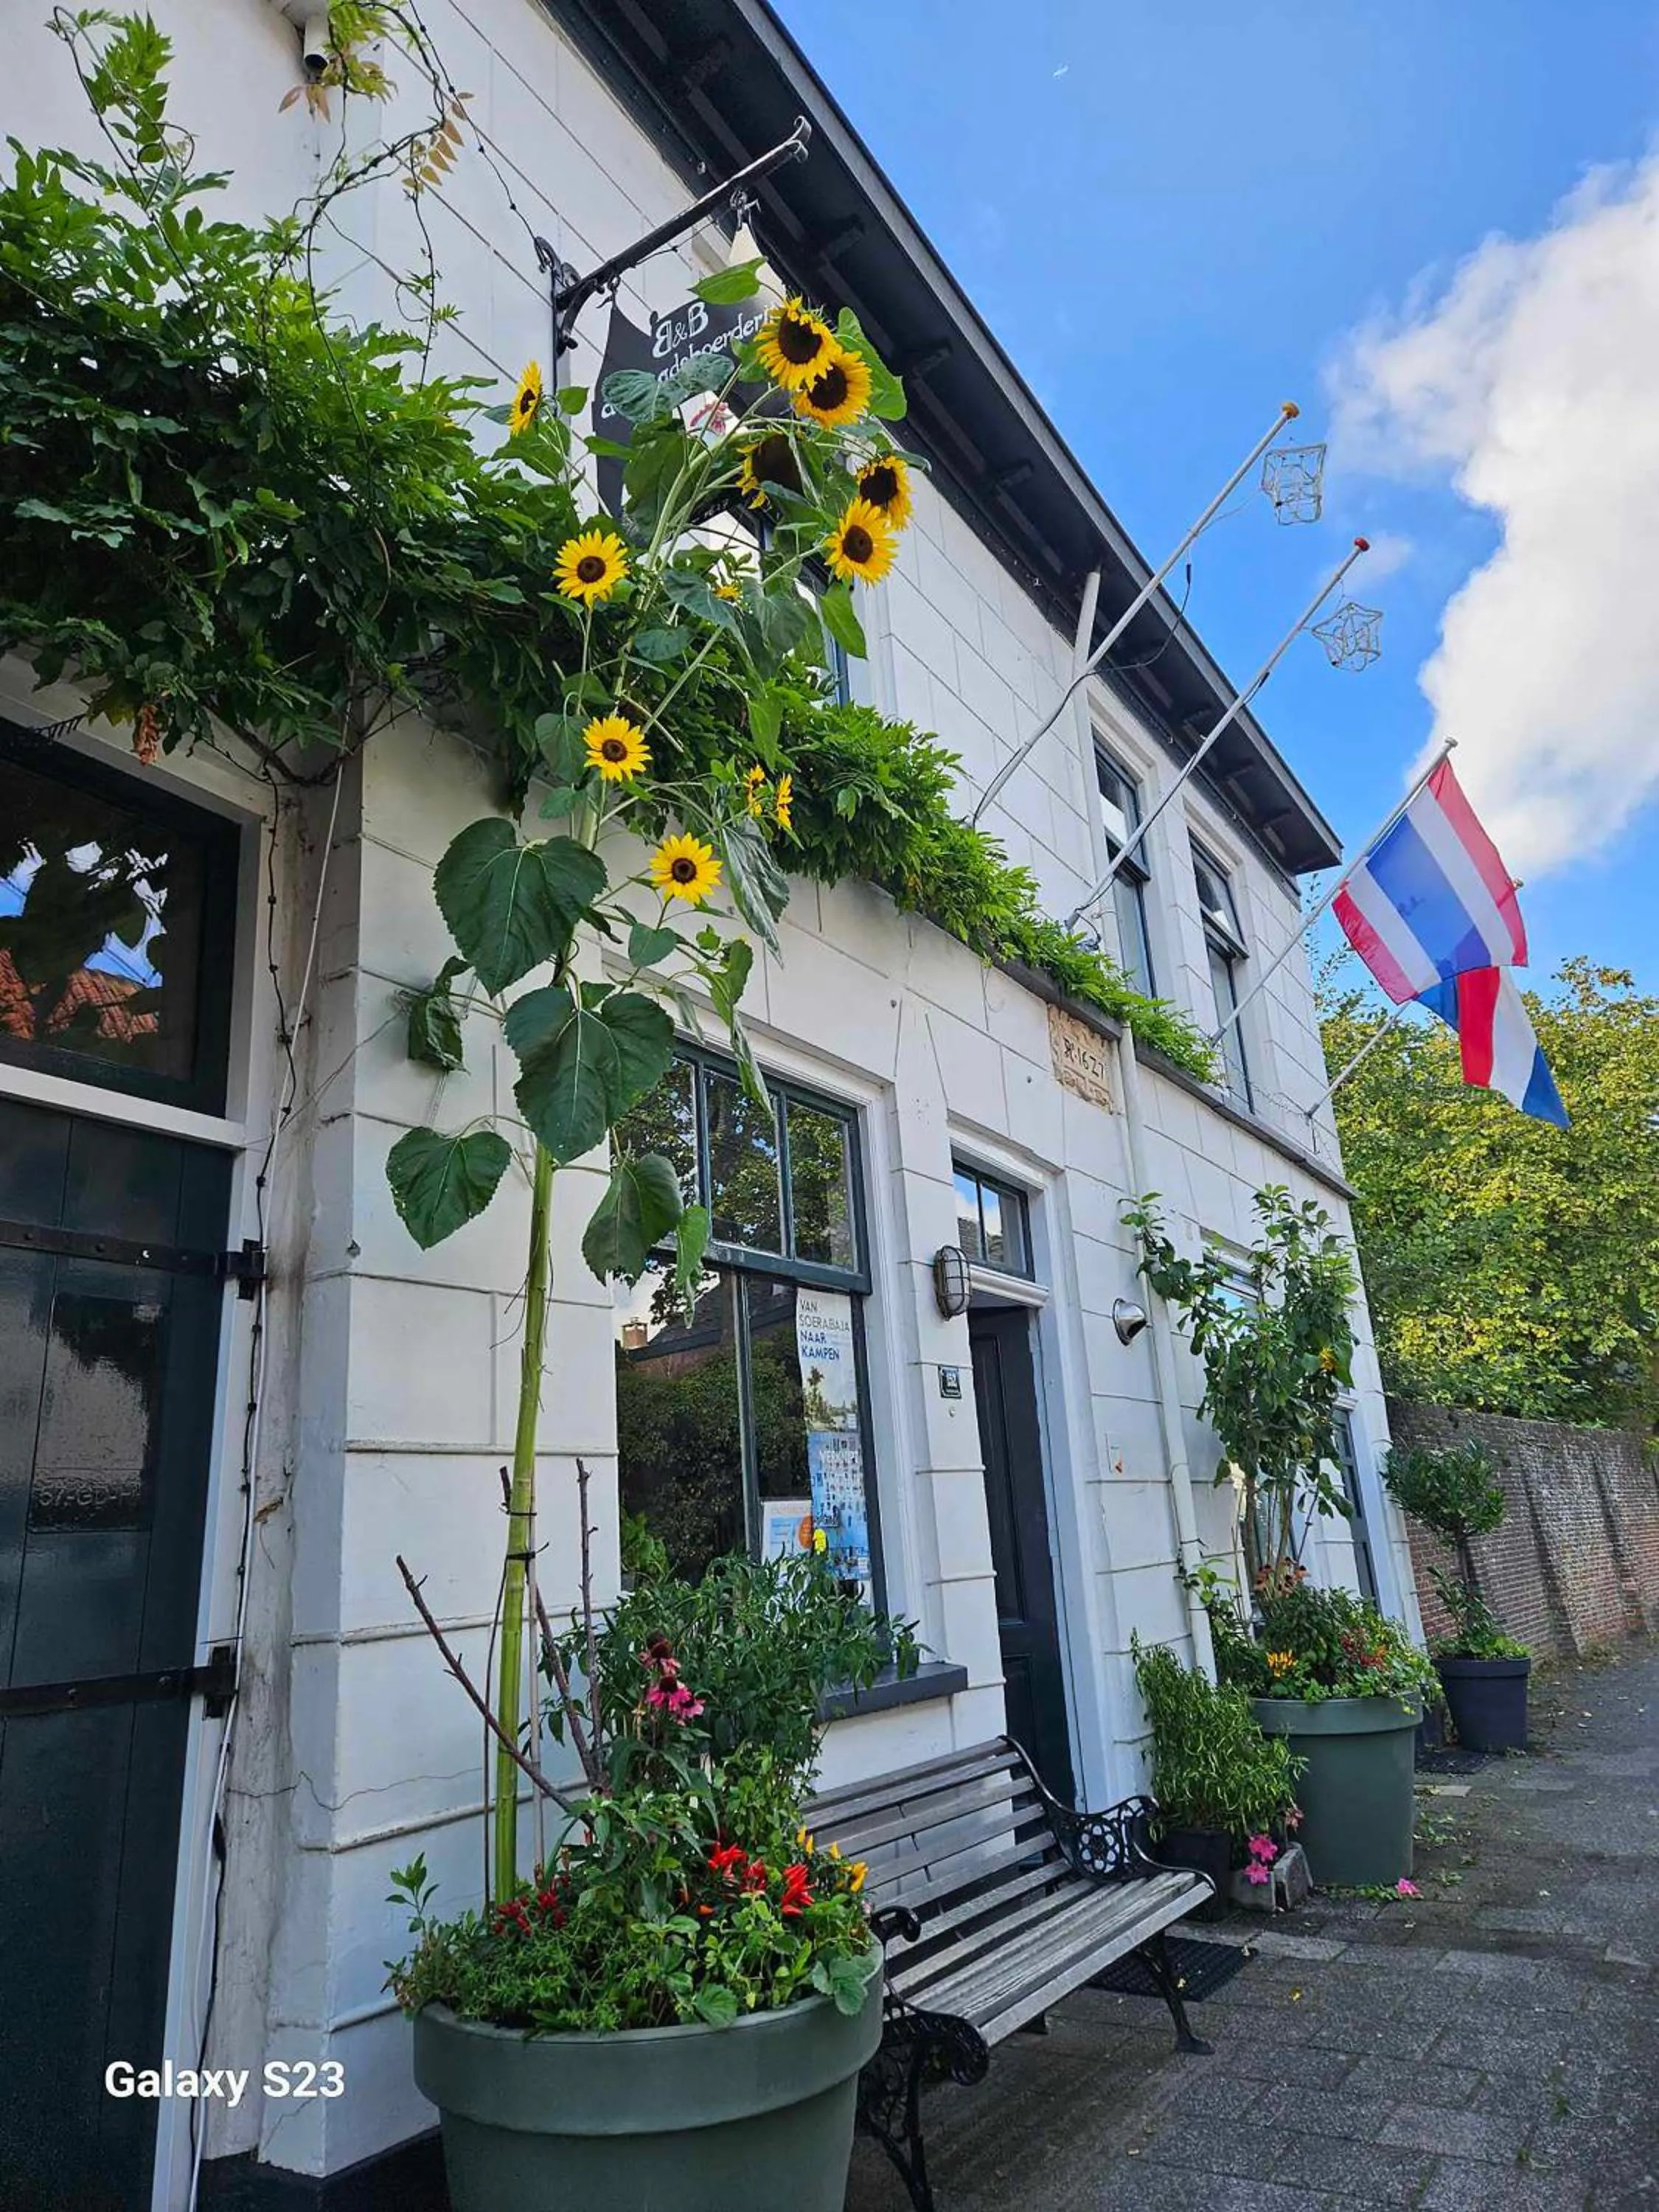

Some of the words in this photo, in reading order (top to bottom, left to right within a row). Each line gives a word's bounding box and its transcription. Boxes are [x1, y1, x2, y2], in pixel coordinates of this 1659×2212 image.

[652, 302, 709, 358] B&B
[800, 1298, 818, 1312] VAN
[799, 1314, 850, 1332] SOERABAJA
[800, 1329, 826, 1344] NAAR
[801, 1345, 840, 1360] KAMPEN
